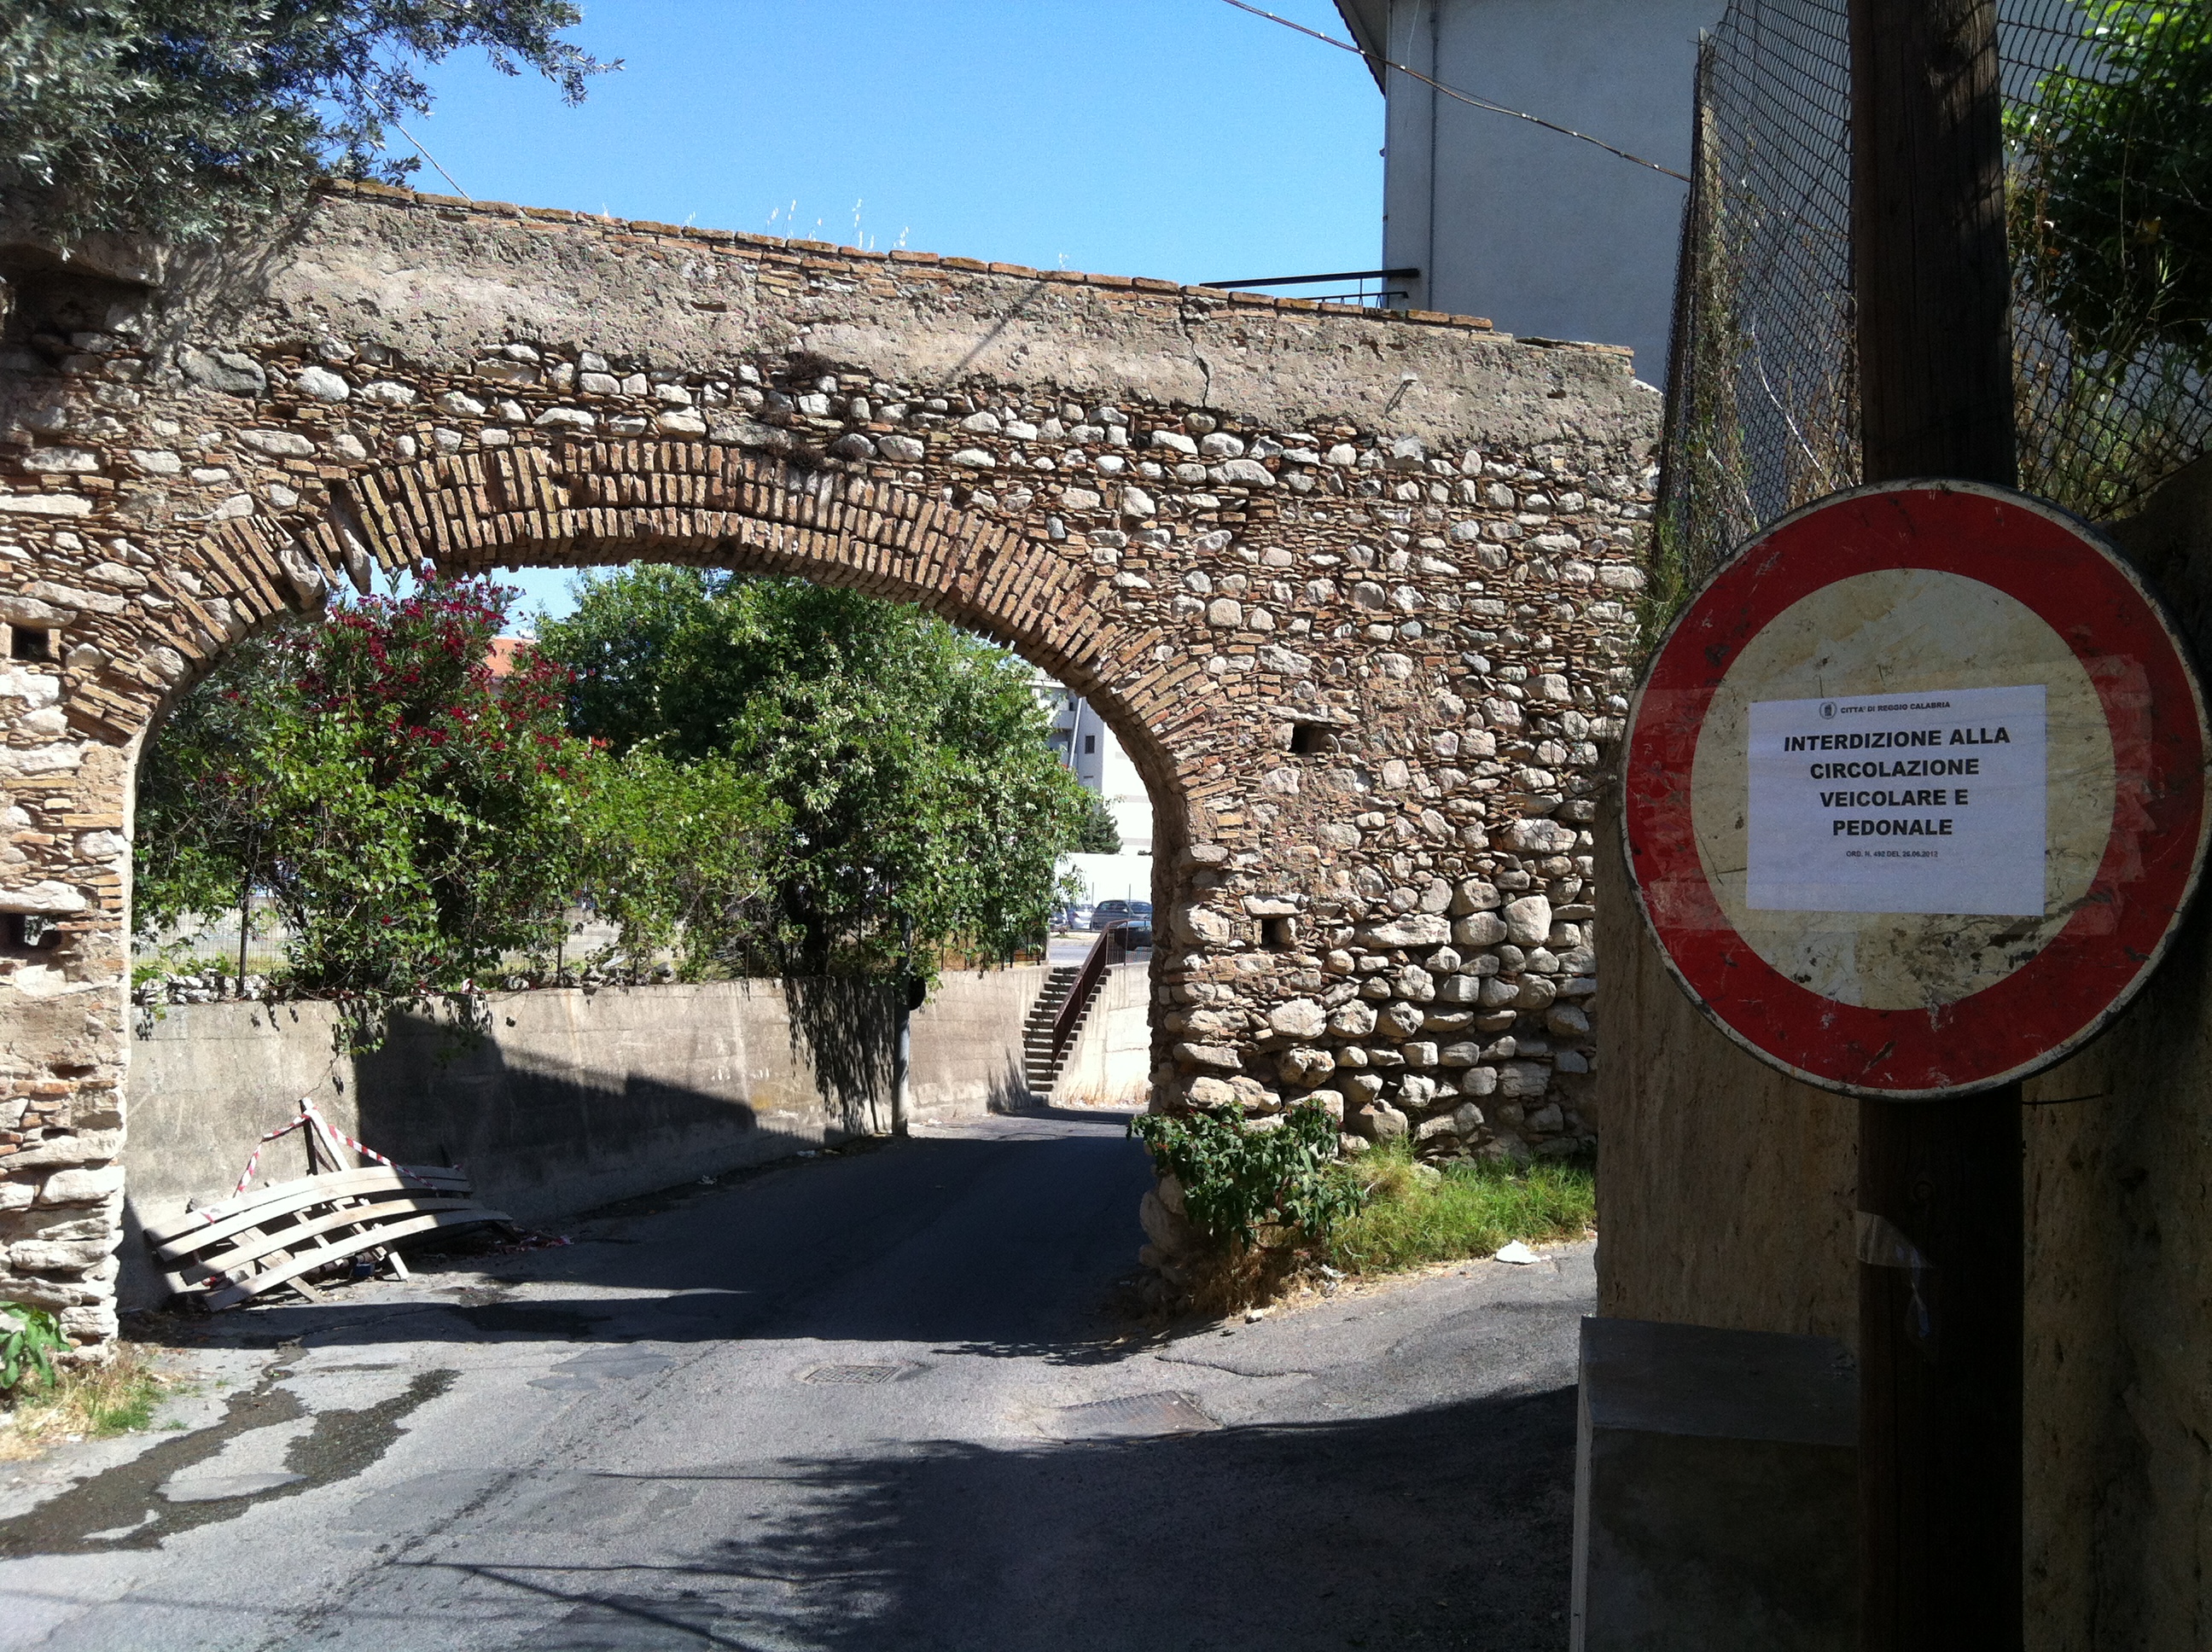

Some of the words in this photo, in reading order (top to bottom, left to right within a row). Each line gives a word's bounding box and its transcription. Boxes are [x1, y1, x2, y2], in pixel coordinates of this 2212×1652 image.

[1877, 704, 1908, 713] REGGIO
[1910, 701, 1951, 711] CALABRIA
[1784, 730, 1942, 753] INTERDIZIONE
[1949, 727, 2011, 746] ALLA
[1809, 758, 1980, 780] CIRCOLAZIONE
[1819, 788, 1947, 808] VEICOLARE
[1955, 788, 1969, 806] E
[1832, 818, 1953, 836] PEDONALE
